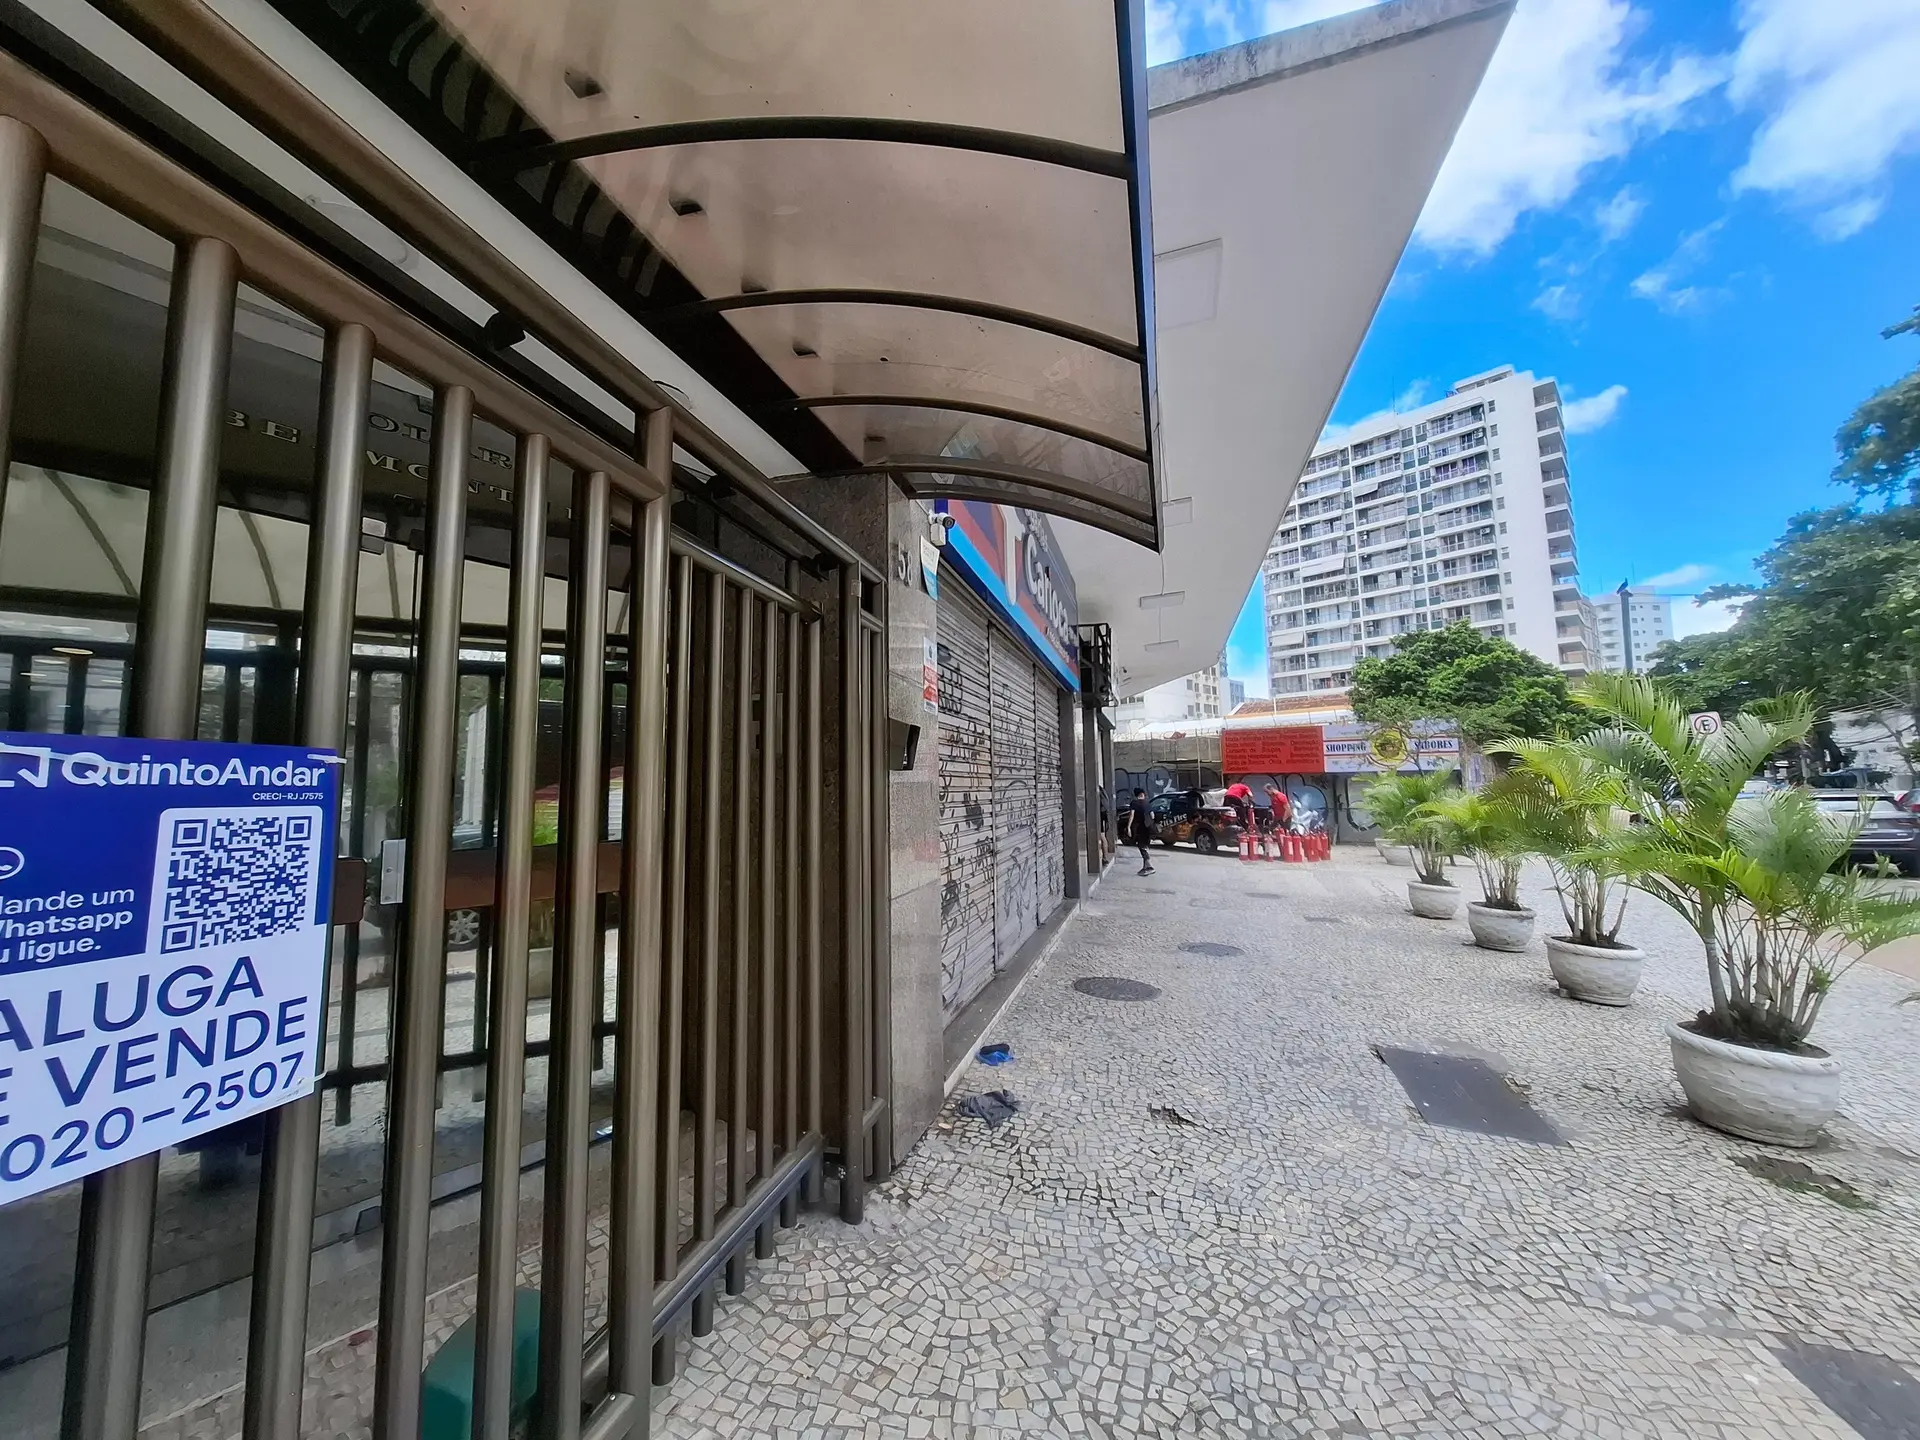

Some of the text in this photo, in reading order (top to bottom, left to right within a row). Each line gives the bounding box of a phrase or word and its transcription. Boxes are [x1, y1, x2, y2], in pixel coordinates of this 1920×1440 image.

[1701, 720, 1711, 731] E
[1325, 742, 1367, 752] SHOPPING
[62, 752, 325, 787] QuintoAndar
[252, 792, 324, 801] CRECI-RJ J7575
[92, 888, 135, 906] um
[0, 910, 133, 938] hatsapp
[18, 937, 101, 963] ligue.
[0, 956, 264, 1052] ALUGA
[44, 996, 308, 1108] VENDE
